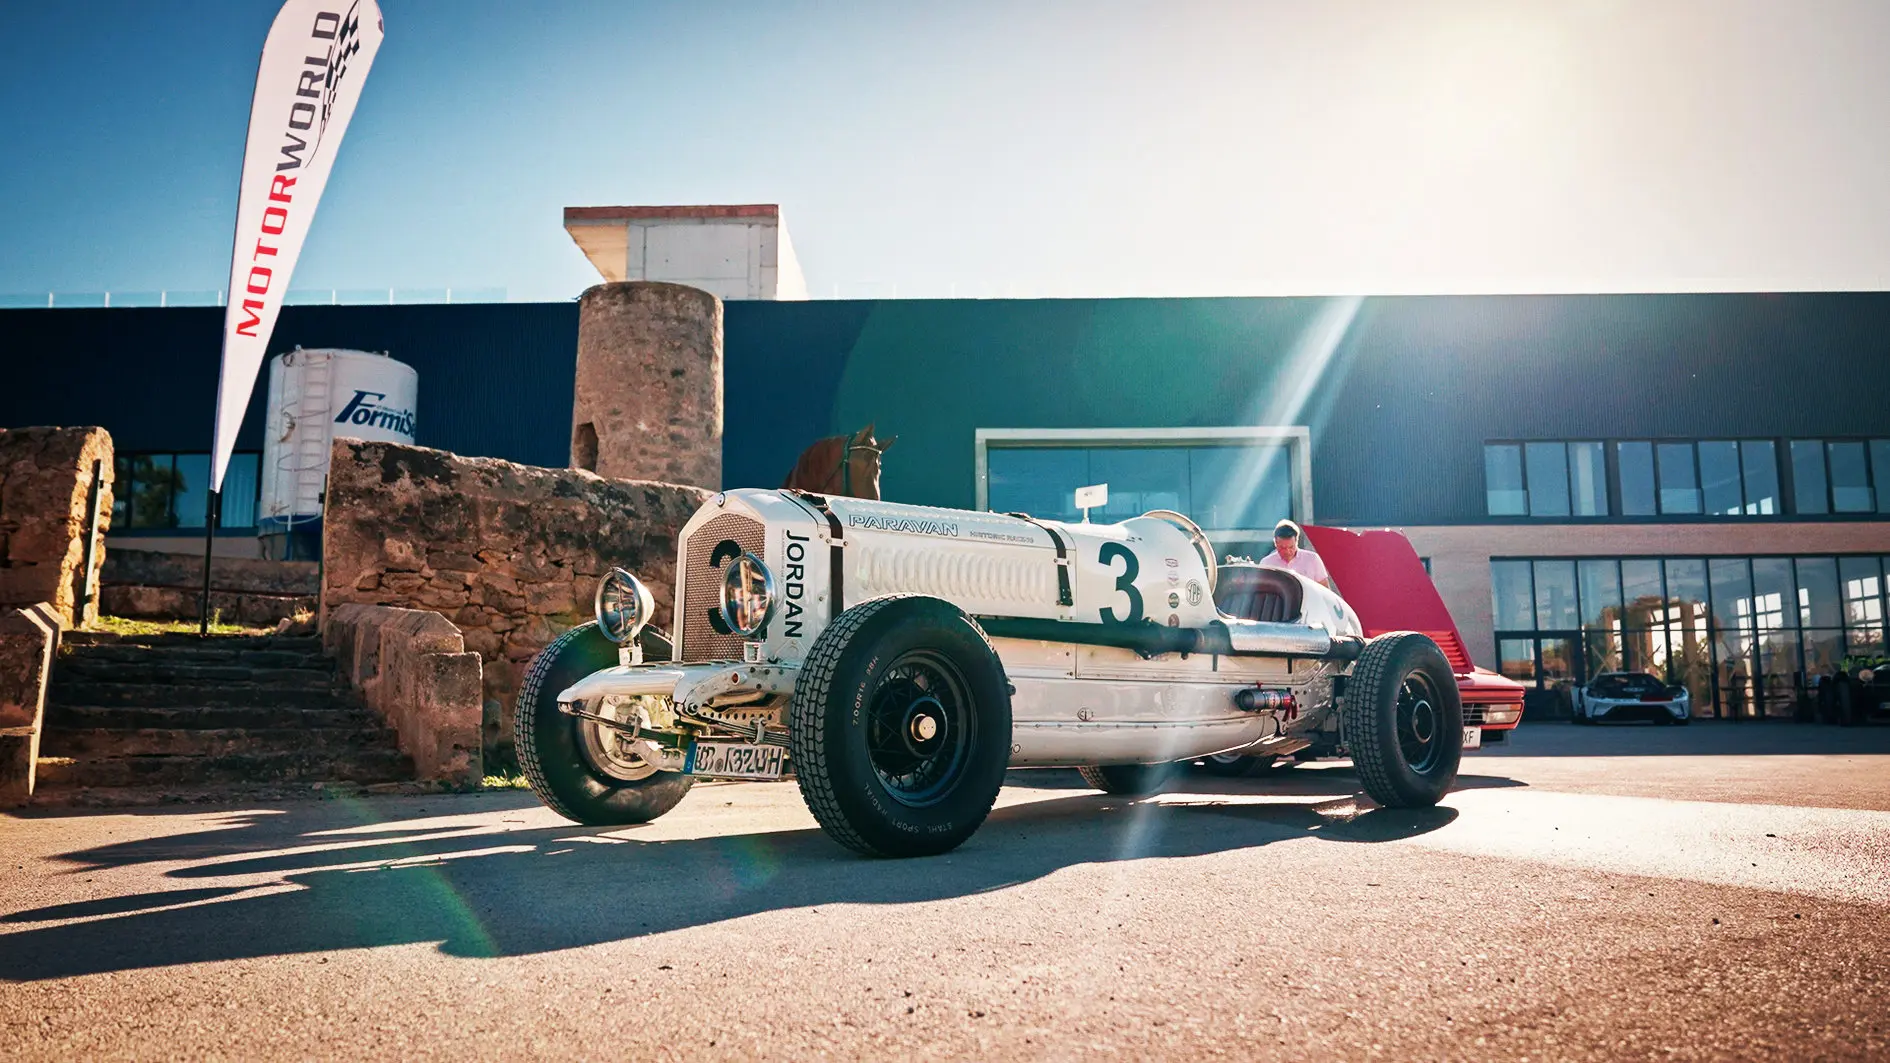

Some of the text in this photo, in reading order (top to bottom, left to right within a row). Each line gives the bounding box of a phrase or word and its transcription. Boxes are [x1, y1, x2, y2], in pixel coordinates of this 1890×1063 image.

[236, 11, 341, 337] MOTORWORLD
[849, 514, 959, 537] PARAVAN
[785, 529, 810, 638] JORDAN
[1099, 542, 1144, 624] 3
